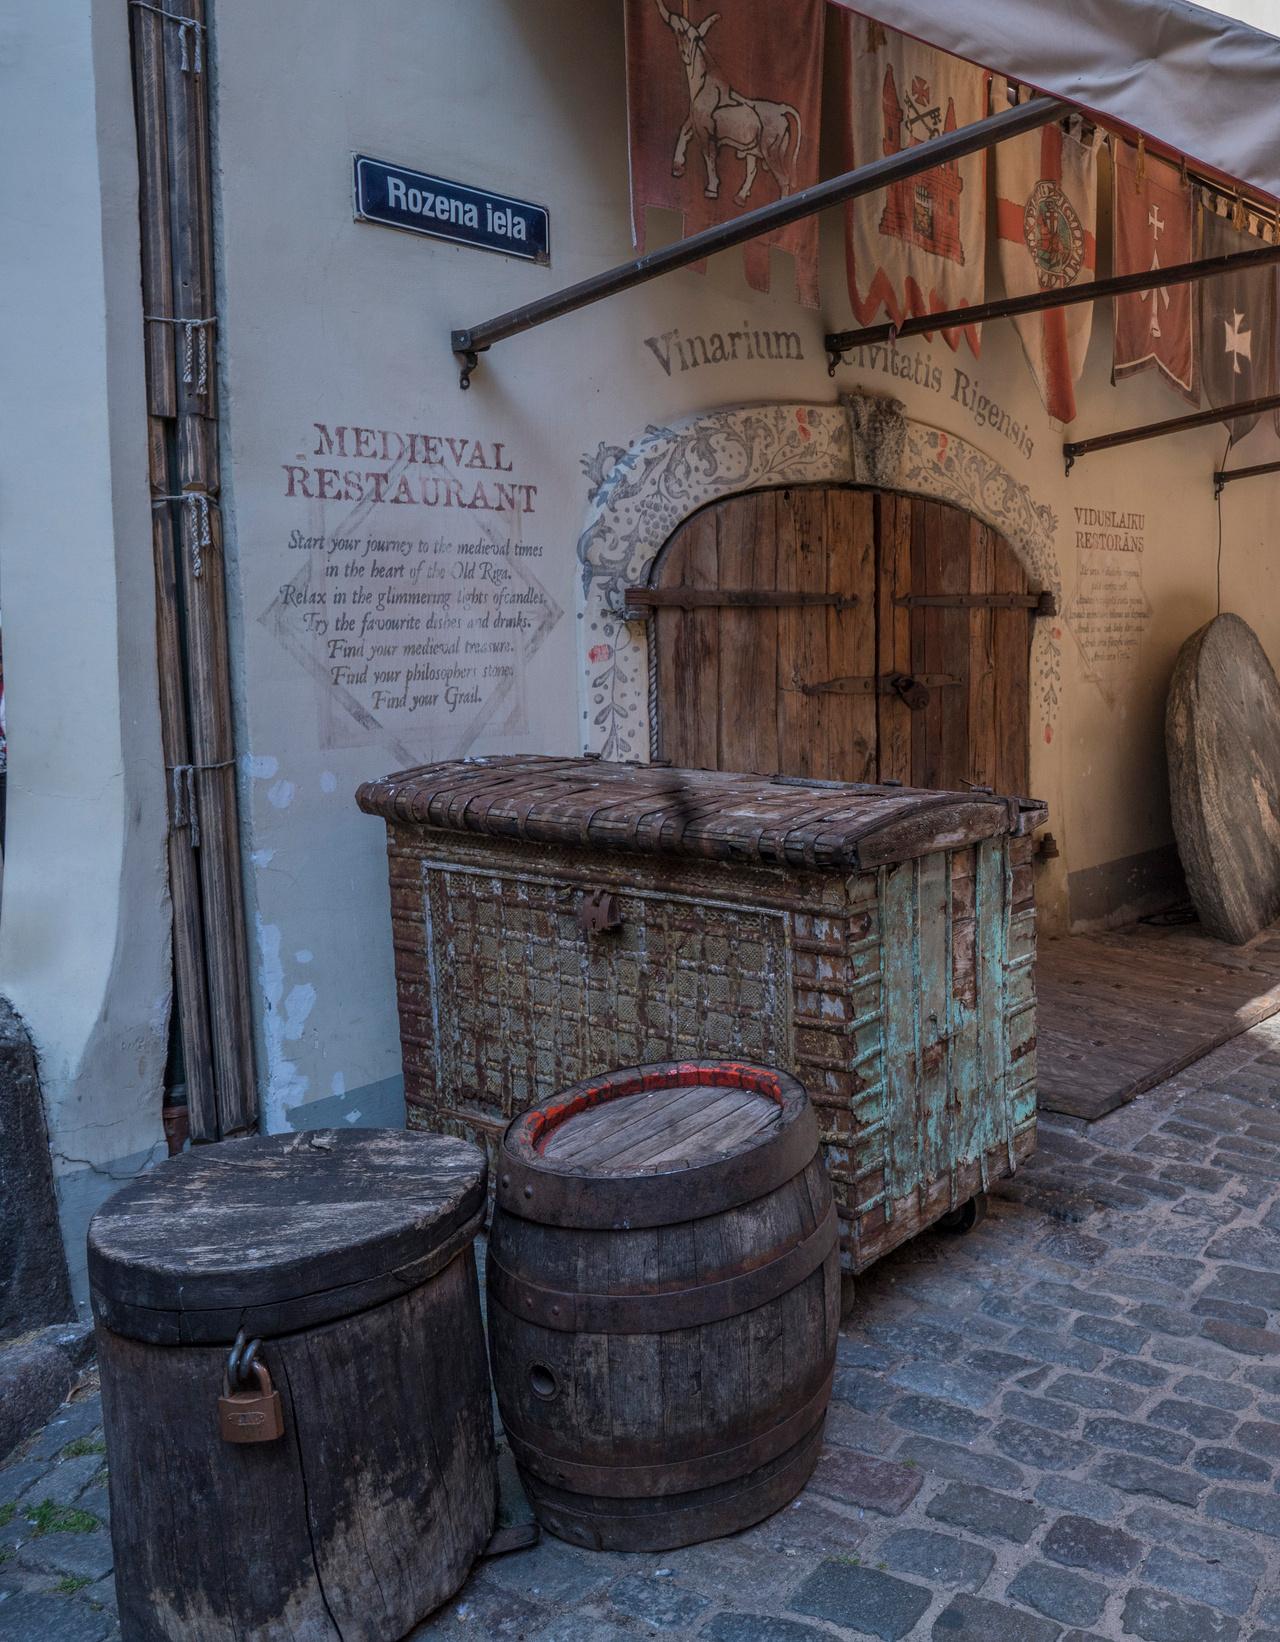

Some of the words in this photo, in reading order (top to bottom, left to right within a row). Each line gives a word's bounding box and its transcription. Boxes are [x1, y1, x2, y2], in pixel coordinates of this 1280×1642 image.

[387, 176, 479, 230] Rozena
[486, 203, 527, 241] iela
[643, 319, 804, 377] Vinarium
[950, 367, 1035, 460] Rigensis
[313, 423, 513, 472] MEDIEVAL
[281, 464, 538, 513] RESTAURANT
[1074, 506, 1145, 531] VIDUSLAIKU
[288, 529, 325, 550] Start
[327, 538, 361, 555] your
[361, 533, 413, 557] journey
[418, 539, 429, 554] to
[457, 537, 511, 556] medieval
[514, 540, 543, 557] times
[1075, 530, 1144, 553] RESTORĀNS
[325, 559, 339, 578] in
[344, 558, 365, 578] the
[370, 559, 405, 578] heart
[409, 560, 426, 586] of
[451, 561, 476, 580] Old
[478, 561, 512, 587] Riga.
[279, 584, 327, 608] Relax
[333, 586, 347, 605] in
[352, 585, 373, 605] the
[375, 585, 452, 612] glimmering
[303, 612, 329, 636] Try
[335, 612, 356, 632] the
[357, 611, 421, 639] favourite
[425, 611, 461, 630] dishes
[493, 610, 532, 634] drinks.
[327, 638, 365, 659] Find
[365, 645, 399, 662] your
[402, 636, 461, 657] medieval
[330, 664, 369, 686] Find
[373, 670, 402, 684] your
[372, 690, 407, 710] Find
[408, 694, 439, 713] your
[444, 684, 483, 713] Grail.
